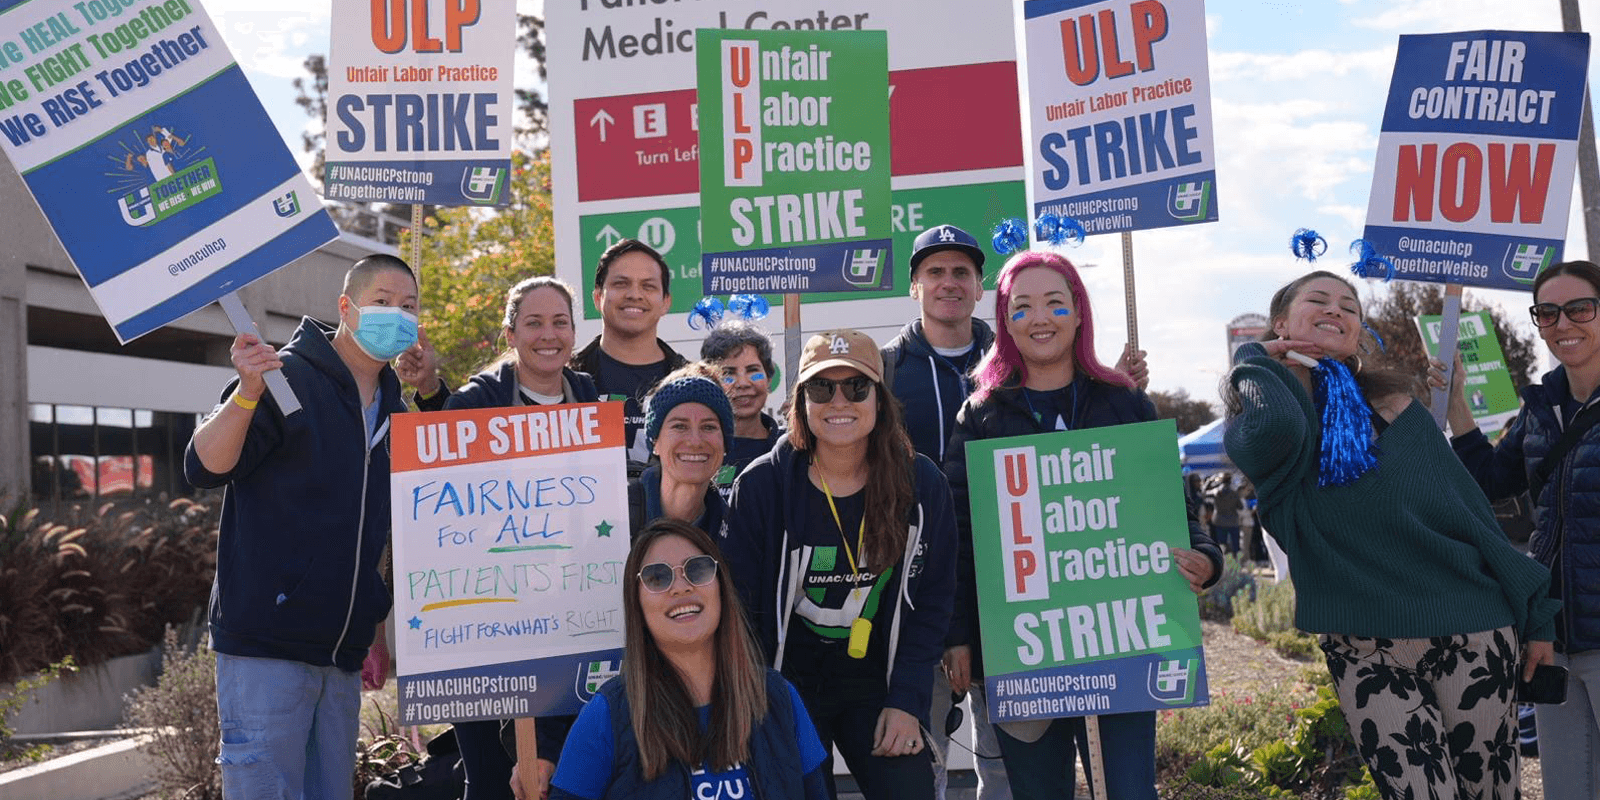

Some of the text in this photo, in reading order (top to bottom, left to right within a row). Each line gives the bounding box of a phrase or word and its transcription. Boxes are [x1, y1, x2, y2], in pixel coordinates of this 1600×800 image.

[0, 41, 24, 70] e
[19, 12, 81, 54] HEAL
[371, 0, 482, 54] ULP
[582, 11, 727, 61] Medic
[1060, 0, 1169, 86] ULP
[24, 43, 91, 93] FIGHT
[86, 0, 192, 59] Together
[1445, 40, 1526, 83] FAIR
[0, 25, 208, 147] We RISE Together
[346, 65, 498, 82] Unfair Labor Practice
[1046, 78, 1192, 121] Unfair Labor Practice
[1408, 86, 1556, 124] CONTRACT
[336, 93, 499, 153] STRIKE
[644, 110, 657, 133] E
[636, 150, 669, 166] Turn
[1039, 104, 1202, 191] STRIKE
[155, 164, 211, 199] TOGETHER
[329, 183, 426, 201] #TogetherWeWin
[330, 166, 433, 185] #UNACUHCPstrong
[1393, 142, 1556, 224] NOW
[158, 201, 170, 212] WE
[190, 186, 202, 197] WE
[201, 179, 216, 192] WIN
[648, 223, 666, 248] U
[730, 189, 867, 247] STRIKE
[938, 228, 955, 242] LA
[168, 237, 227, 276] @unacuhcp
[711, 255, 816, 273] #UNACUHCPstrong
[1399, 236, 1473, 258] @unacuhcp
[711, 274, 809, 292] #TogetherWeWin
[829, 334, 849, 354] LA
[415, 406, 600, 464] ULP STRIKE
[412, 476, 597, 520] FAIRNESS
[495, 513, 564, 543] ALL
[408, 561, 625, 600] PATIENTS FIRST
[425, 623, 474, 649] FIGHT
[566, 609, 618, 631] RIGHT
[1013, 594, 1171, 666] STRIKE
[406, 674, 537, 698] #UNACUHCPstrong
[996, 673, 1117, 698] #UNACUHCPstrong
[406, 695, 528, 721] #TogetherWeWin
[997, 694, 1110, 718] #TogetherWeWin
